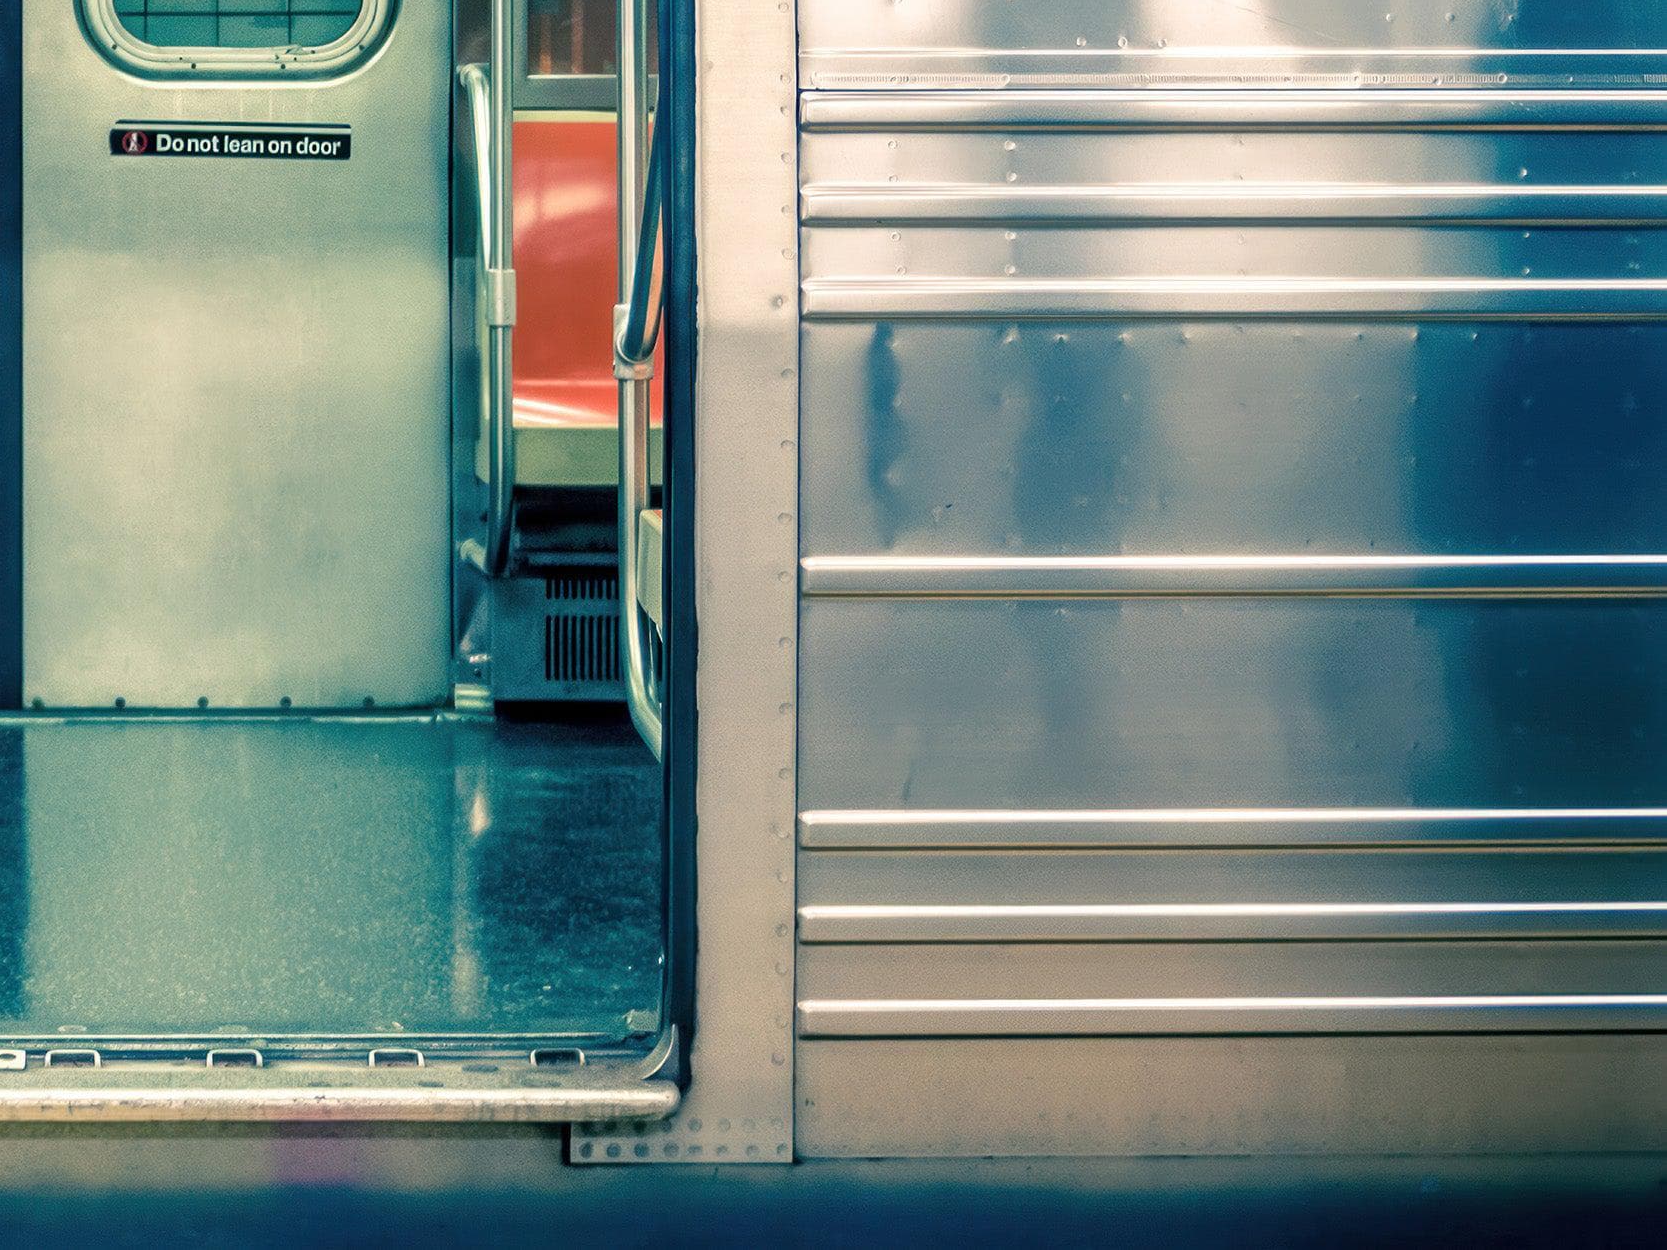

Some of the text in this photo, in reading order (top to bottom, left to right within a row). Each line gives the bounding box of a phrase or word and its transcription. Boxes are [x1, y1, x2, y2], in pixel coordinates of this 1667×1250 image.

[155, 133, 342, 156] Do not lean on door
